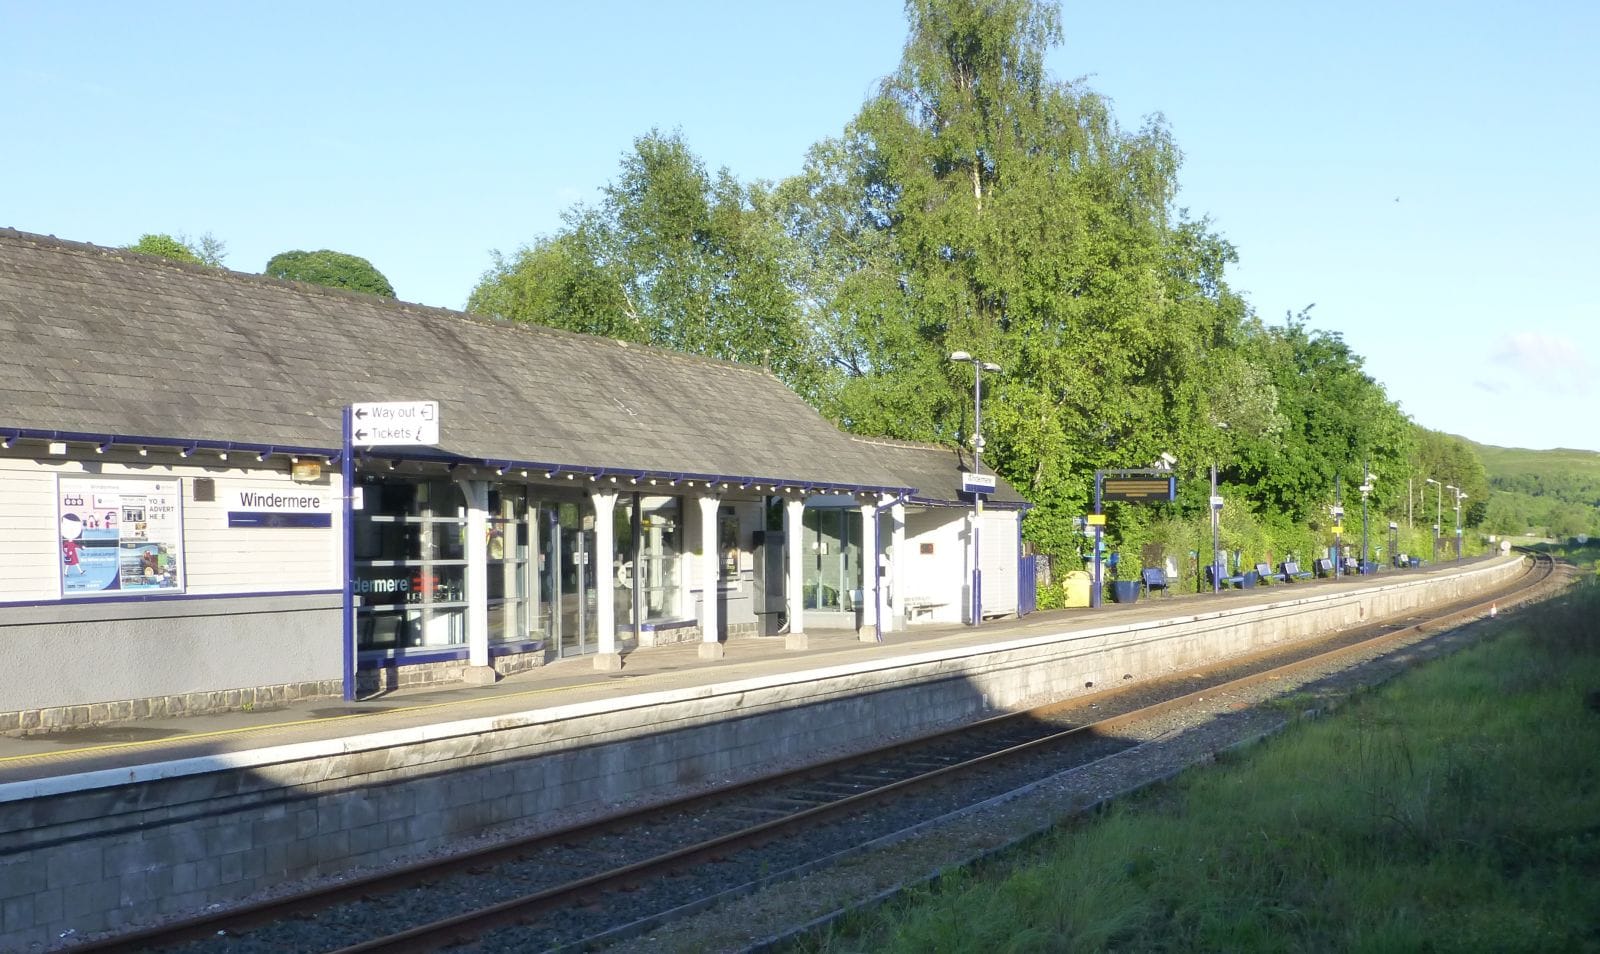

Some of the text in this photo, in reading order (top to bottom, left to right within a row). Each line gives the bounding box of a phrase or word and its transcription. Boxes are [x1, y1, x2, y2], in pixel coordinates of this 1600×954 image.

[372, 407, 415, 420] Way out
[371, 427, 412, 439] Tickets
[240, 492, 320, 509] Windermere
